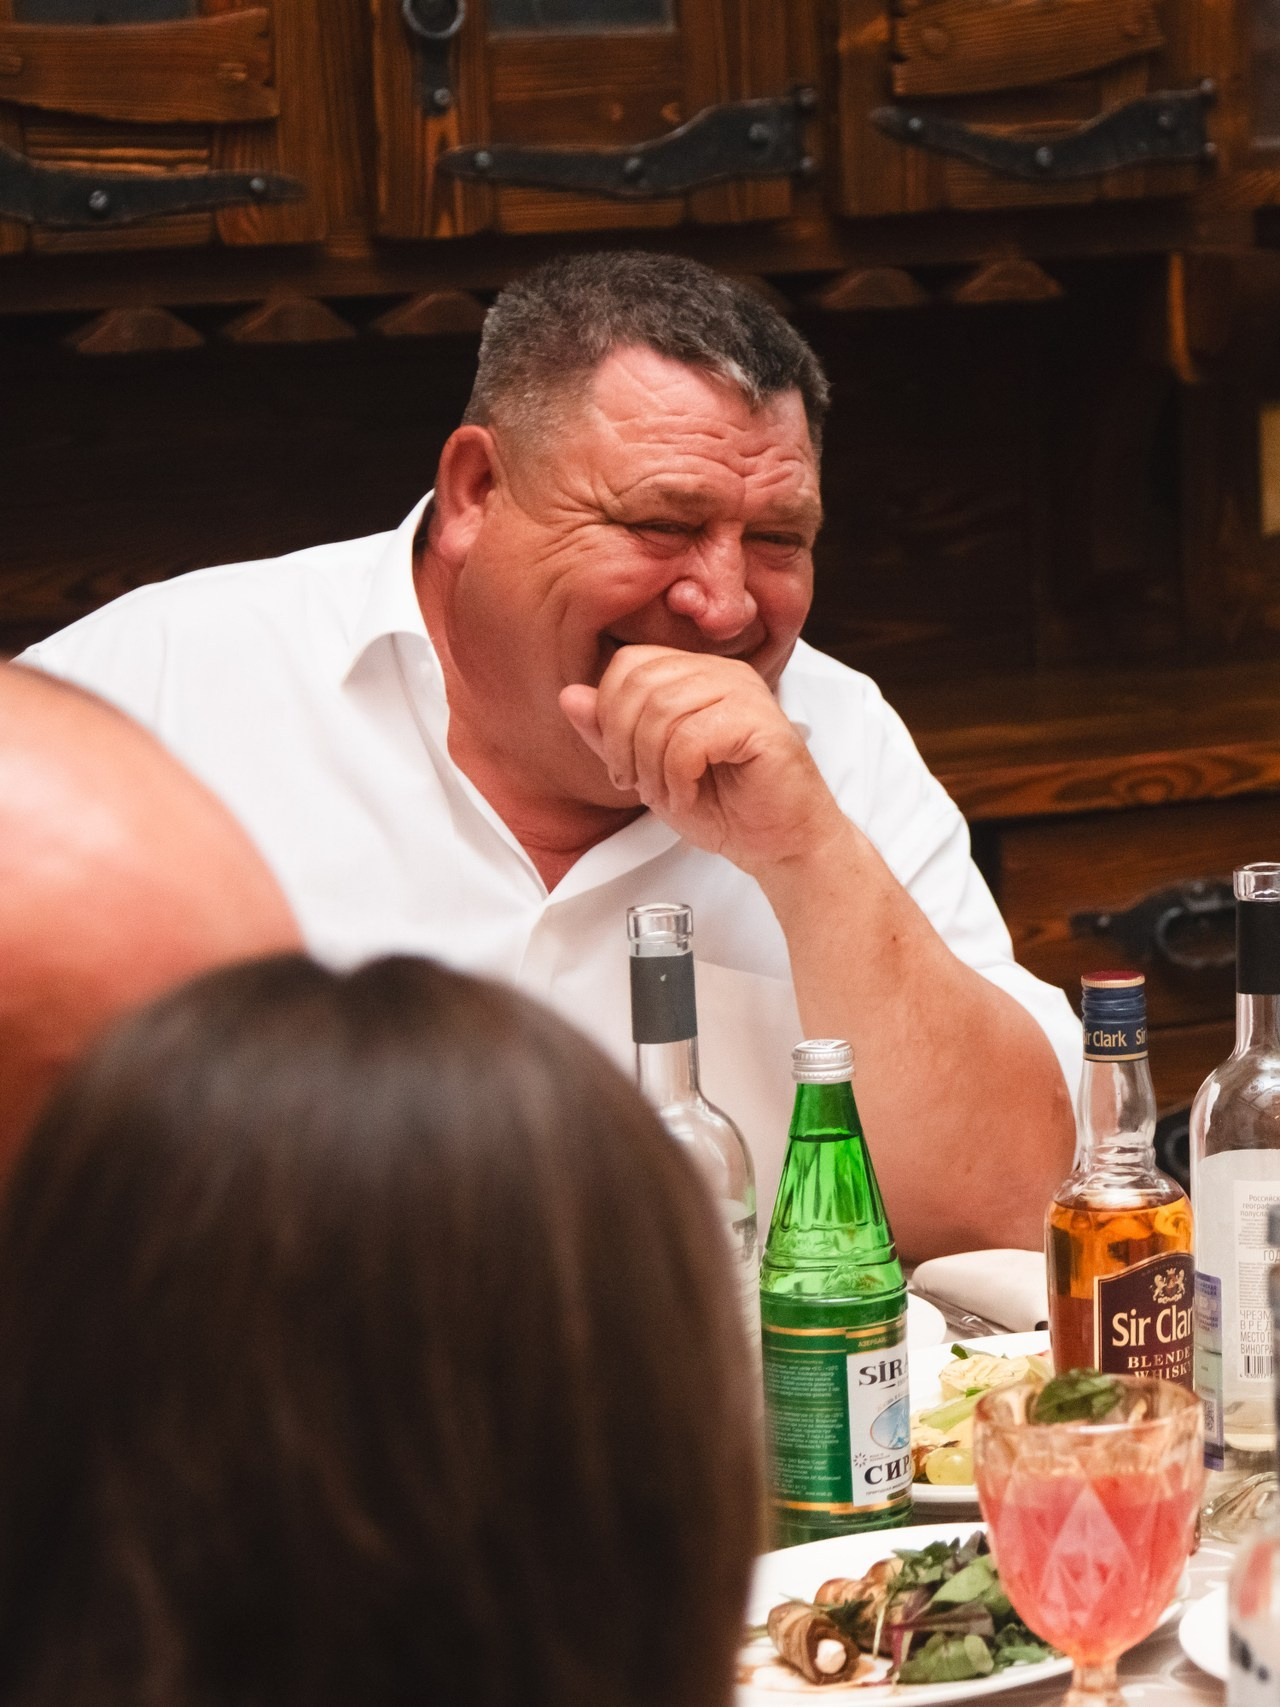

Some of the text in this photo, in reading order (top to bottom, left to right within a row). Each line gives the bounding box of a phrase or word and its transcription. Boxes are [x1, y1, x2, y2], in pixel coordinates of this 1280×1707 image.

[1092, 1029, 1128, 1047] Clark
[1239, 1310, 1273, 1320] ЧРЕЗМ
[1112, 1308, 1151, 1347] Sir
[1156, 1304, 1193, 1344] Clar
[1240, 1320, 1273, 1331] ВРЕД
[1240, 1332, 1265, 1342] МЕСТО
[1240, 1344, 1273, 1354] ВИНОГРА
[1127, 1346, 1190, 1369] BLENDE
[864, 1454, 911, 1485] СИР
